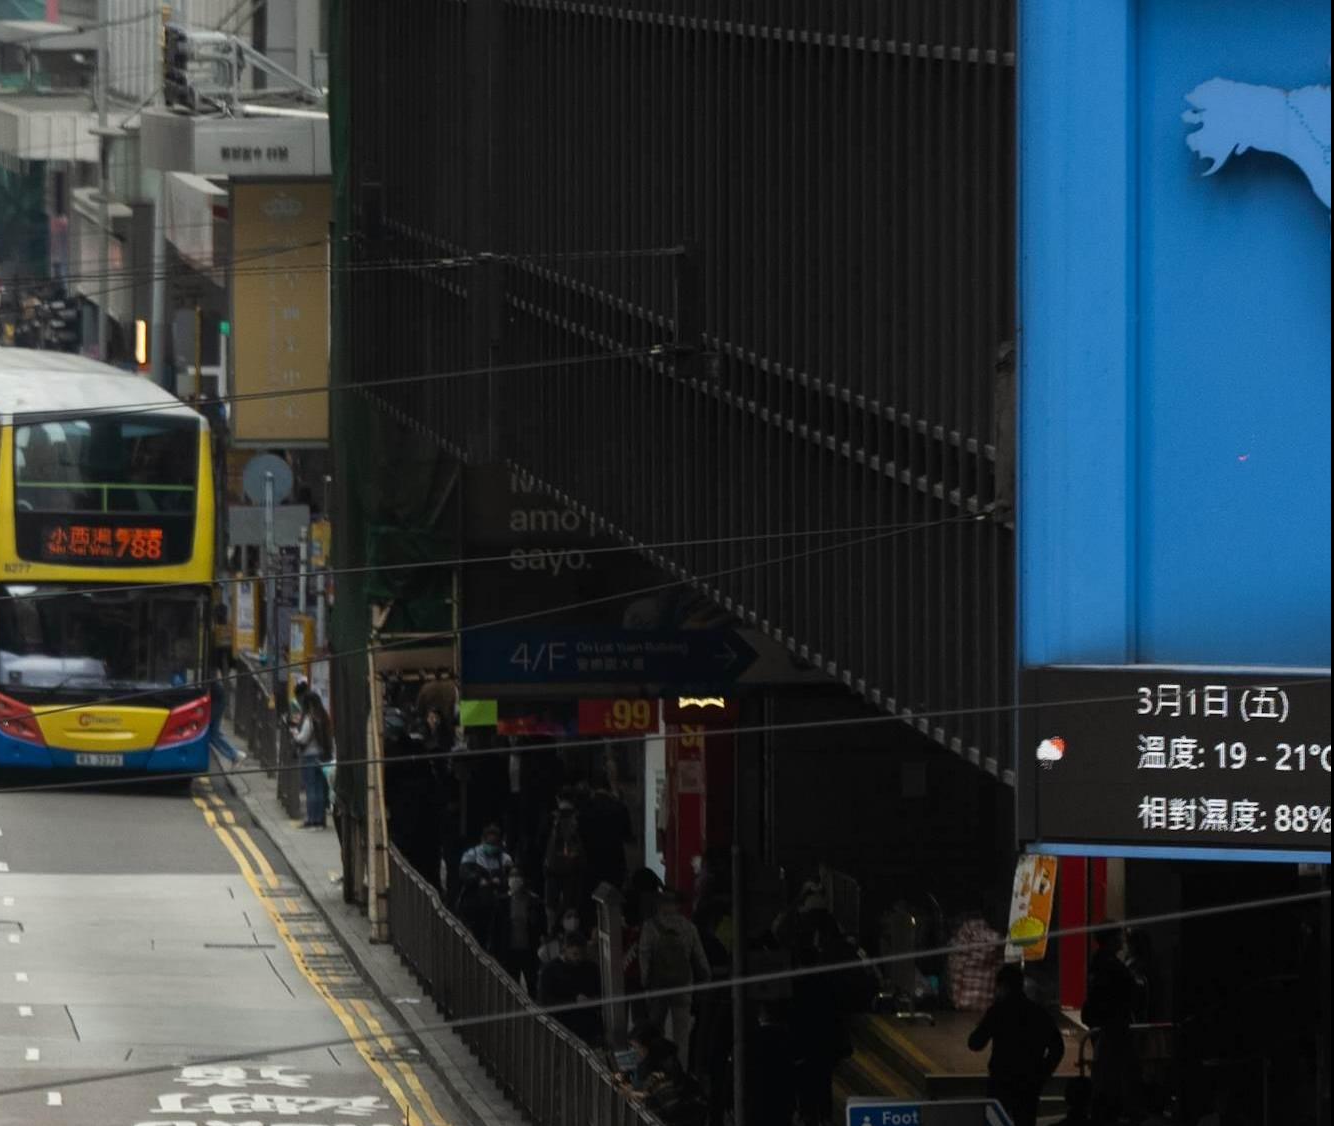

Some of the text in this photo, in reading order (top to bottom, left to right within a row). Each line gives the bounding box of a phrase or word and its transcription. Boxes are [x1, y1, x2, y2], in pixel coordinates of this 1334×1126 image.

[115, 528, 163, 560] 788
[510, 642, 567, 672] 4/F
[1136, 684, 1290, 722] 3月1日 (五)
[1214, 742, 1247, 769] 19
[1274, 804, 1331, 833] 88%
[882, 1110, 920, 1126] Foot
